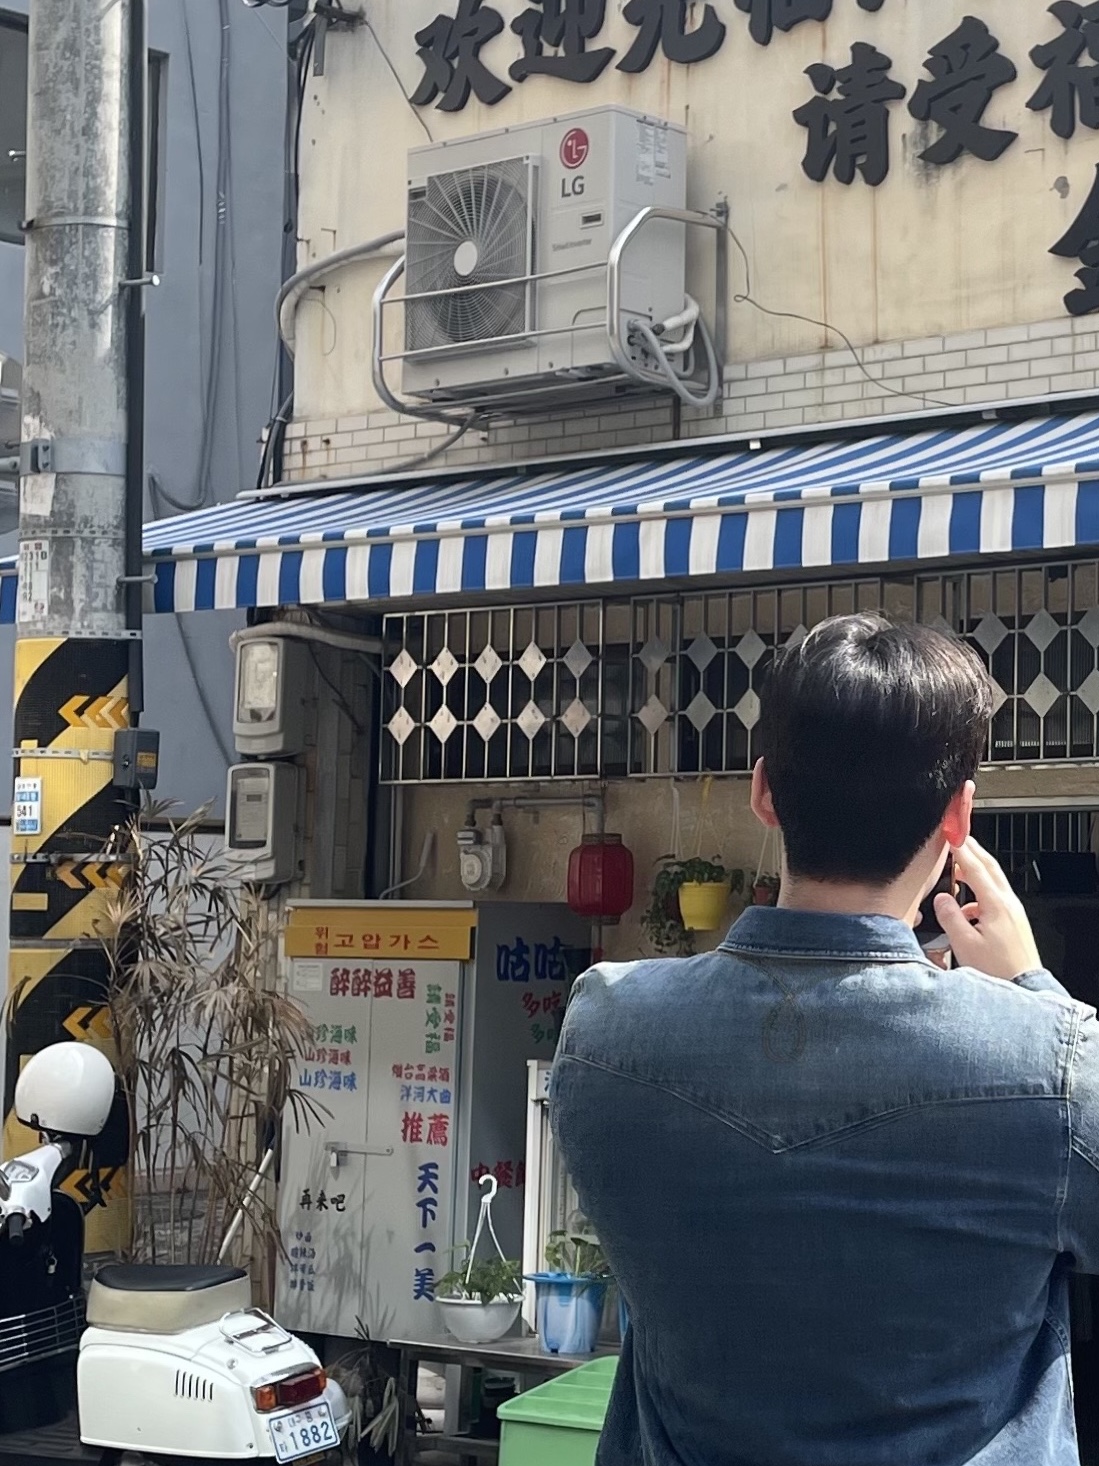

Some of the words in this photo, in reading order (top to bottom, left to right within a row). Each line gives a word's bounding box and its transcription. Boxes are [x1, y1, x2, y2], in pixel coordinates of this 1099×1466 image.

[561, 175, 585, 198] LG
[315, 926, 328, 955] 위험
[333, 933, 439, 950] 고압가스
[312, 1022, 357, 1045] 珍海味
[304, 1047, 352, 1066] 山珍海味
[299, 1068, 357, 1093] 山珍海味
[401, 1111, 450, 1147] 推薦
[299, 1188, 346, 1212] 再来吧
[413, 1162, 439, 1302] 天下一美
[290, 1421, 333, 1451] 1882
